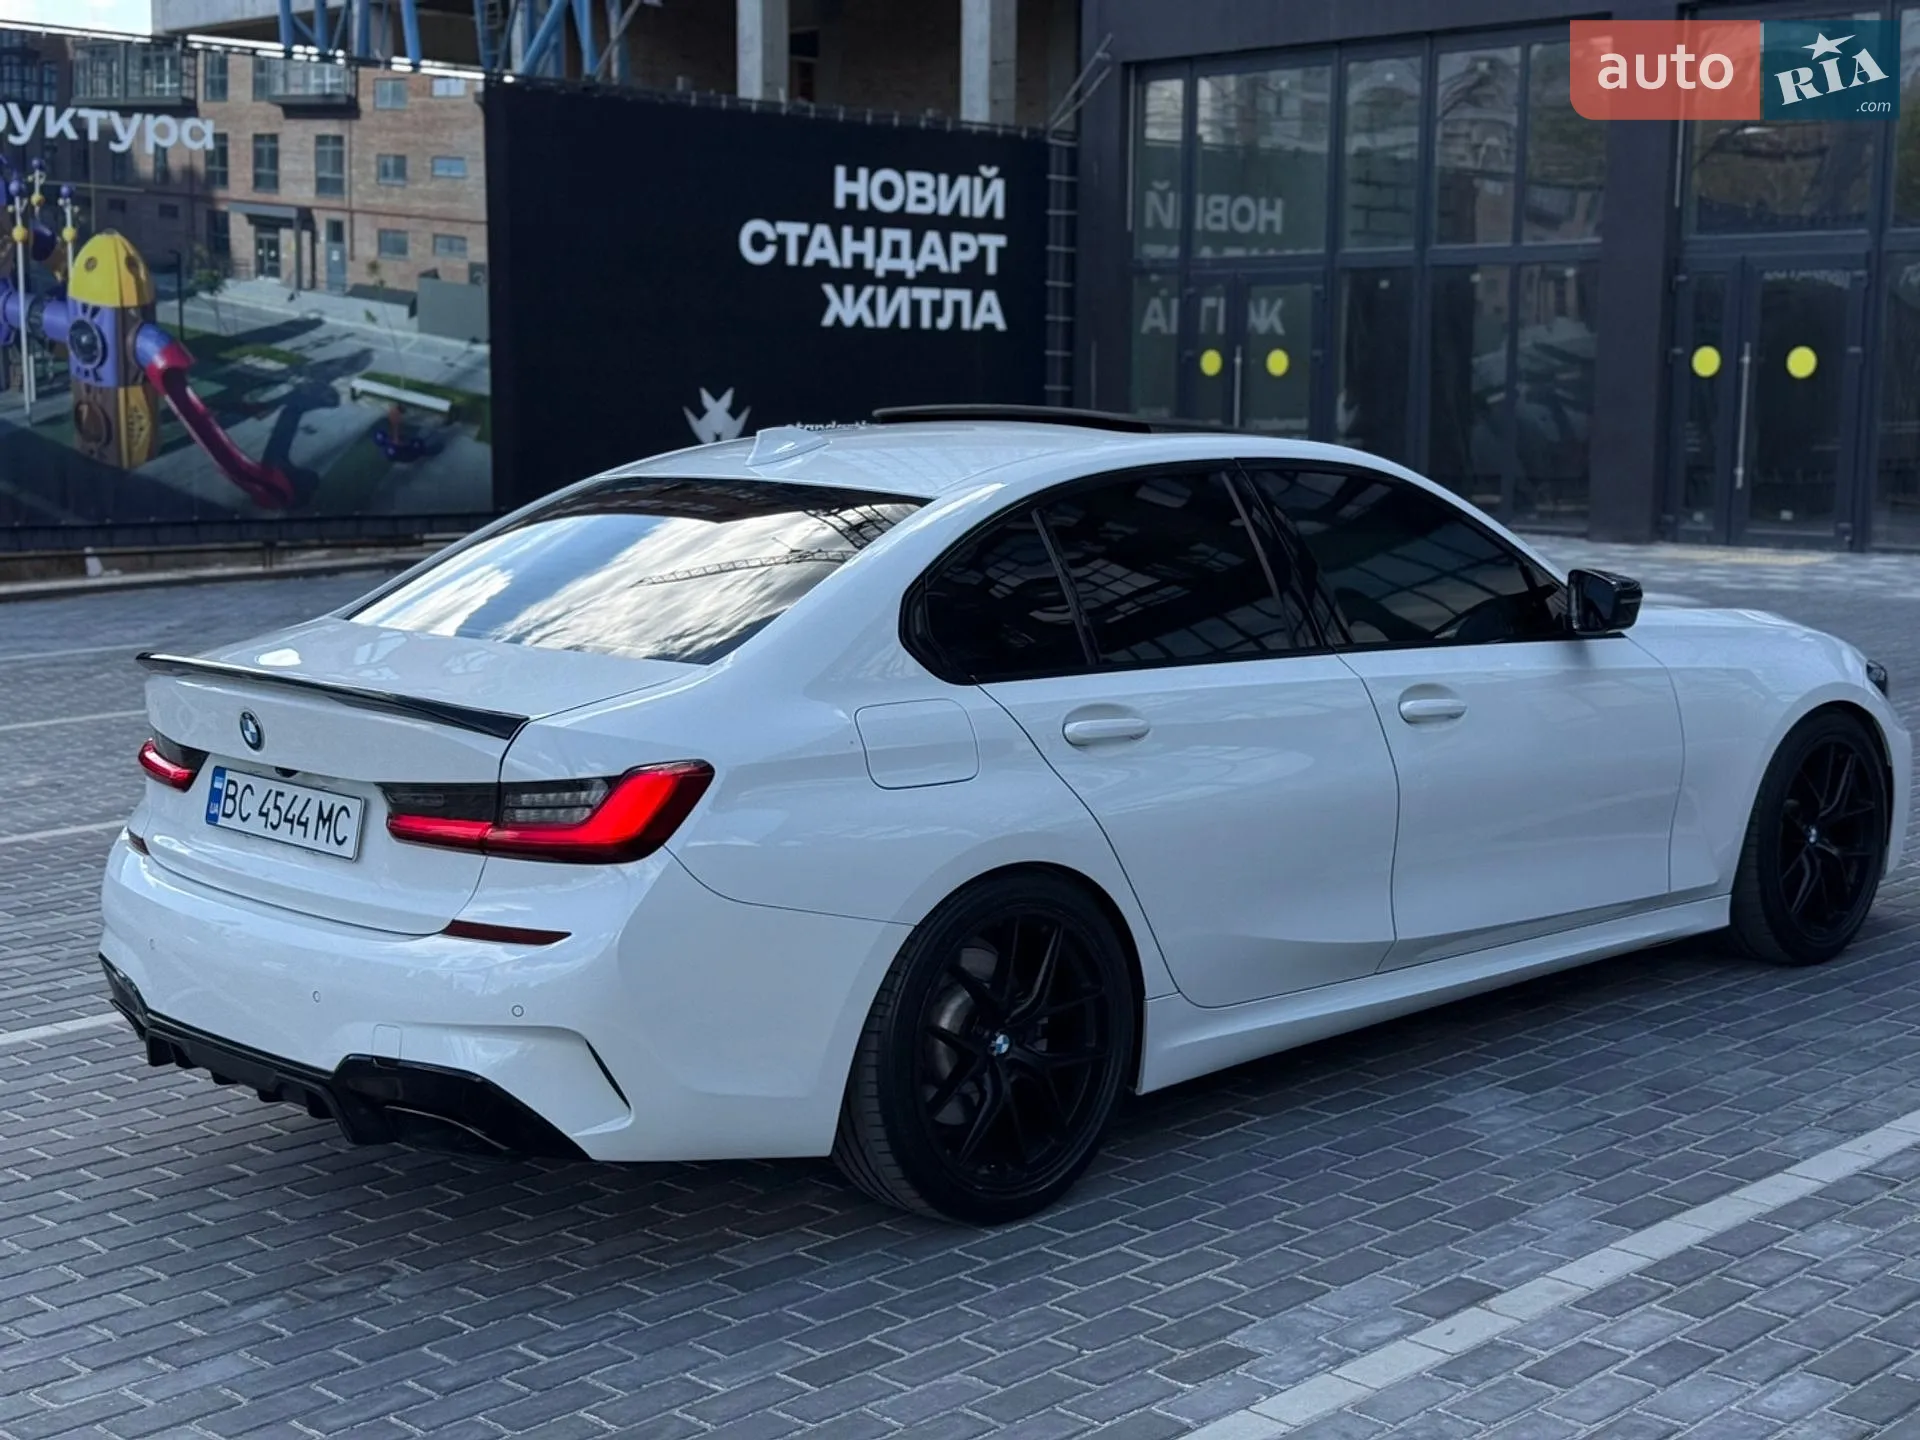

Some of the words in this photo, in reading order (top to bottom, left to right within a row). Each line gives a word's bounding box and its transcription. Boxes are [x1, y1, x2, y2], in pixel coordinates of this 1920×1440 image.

[834, 164, 1005, 220] НОВИЙ
[738, 218, 1008, 280] СТАНДАРТ
[820, 283, 1008, 332] ЖИТЛА
[221, 778, 254, 822] BC
[258, 789, 312, 838] 4544
[314, 800, 351, 846] MC
